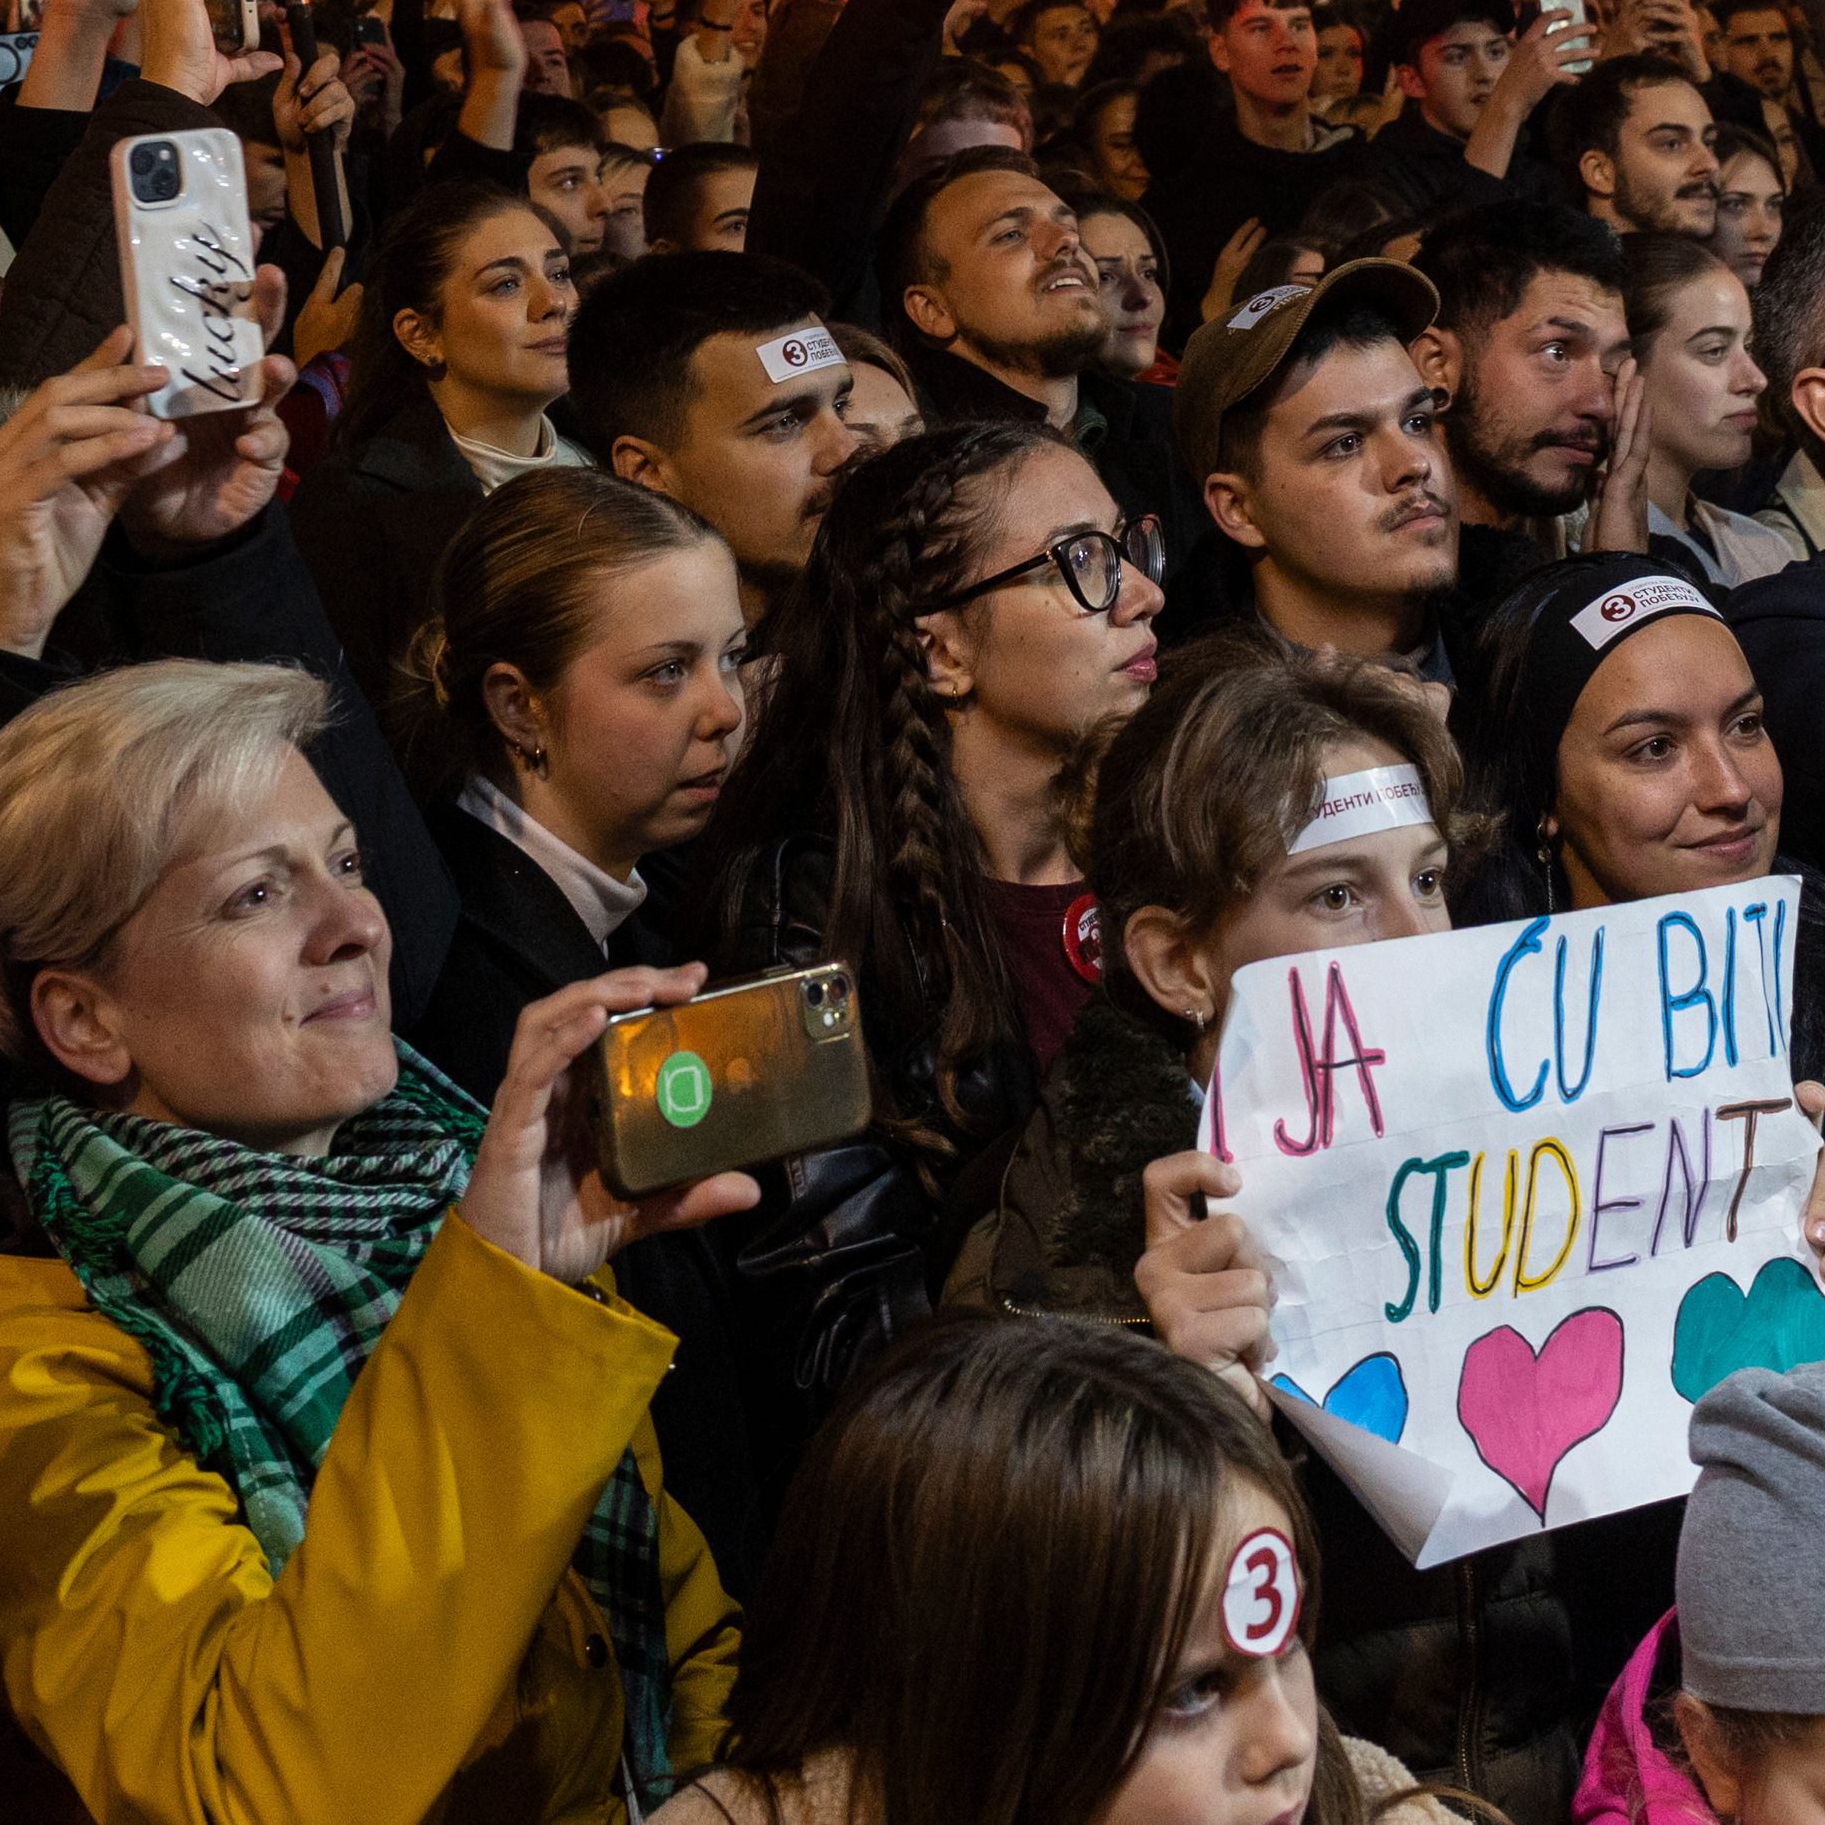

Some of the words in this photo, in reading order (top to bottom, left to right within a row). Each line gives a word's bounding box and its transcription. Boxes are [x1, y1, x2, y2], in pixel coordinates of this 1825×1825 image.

[785, 341, 806, 365] 3
[1604, 596, 1632, 620] 3
[1632, 584, 1695, 600] СТУДЕНТИ
[1274, 960, 1386, 1157] JA
[1657, 898, 1787, 1083] BITI
[1385, 1097, 1793, 1323] STUDENT
[1245, 1547, 1283, 1640] 3
